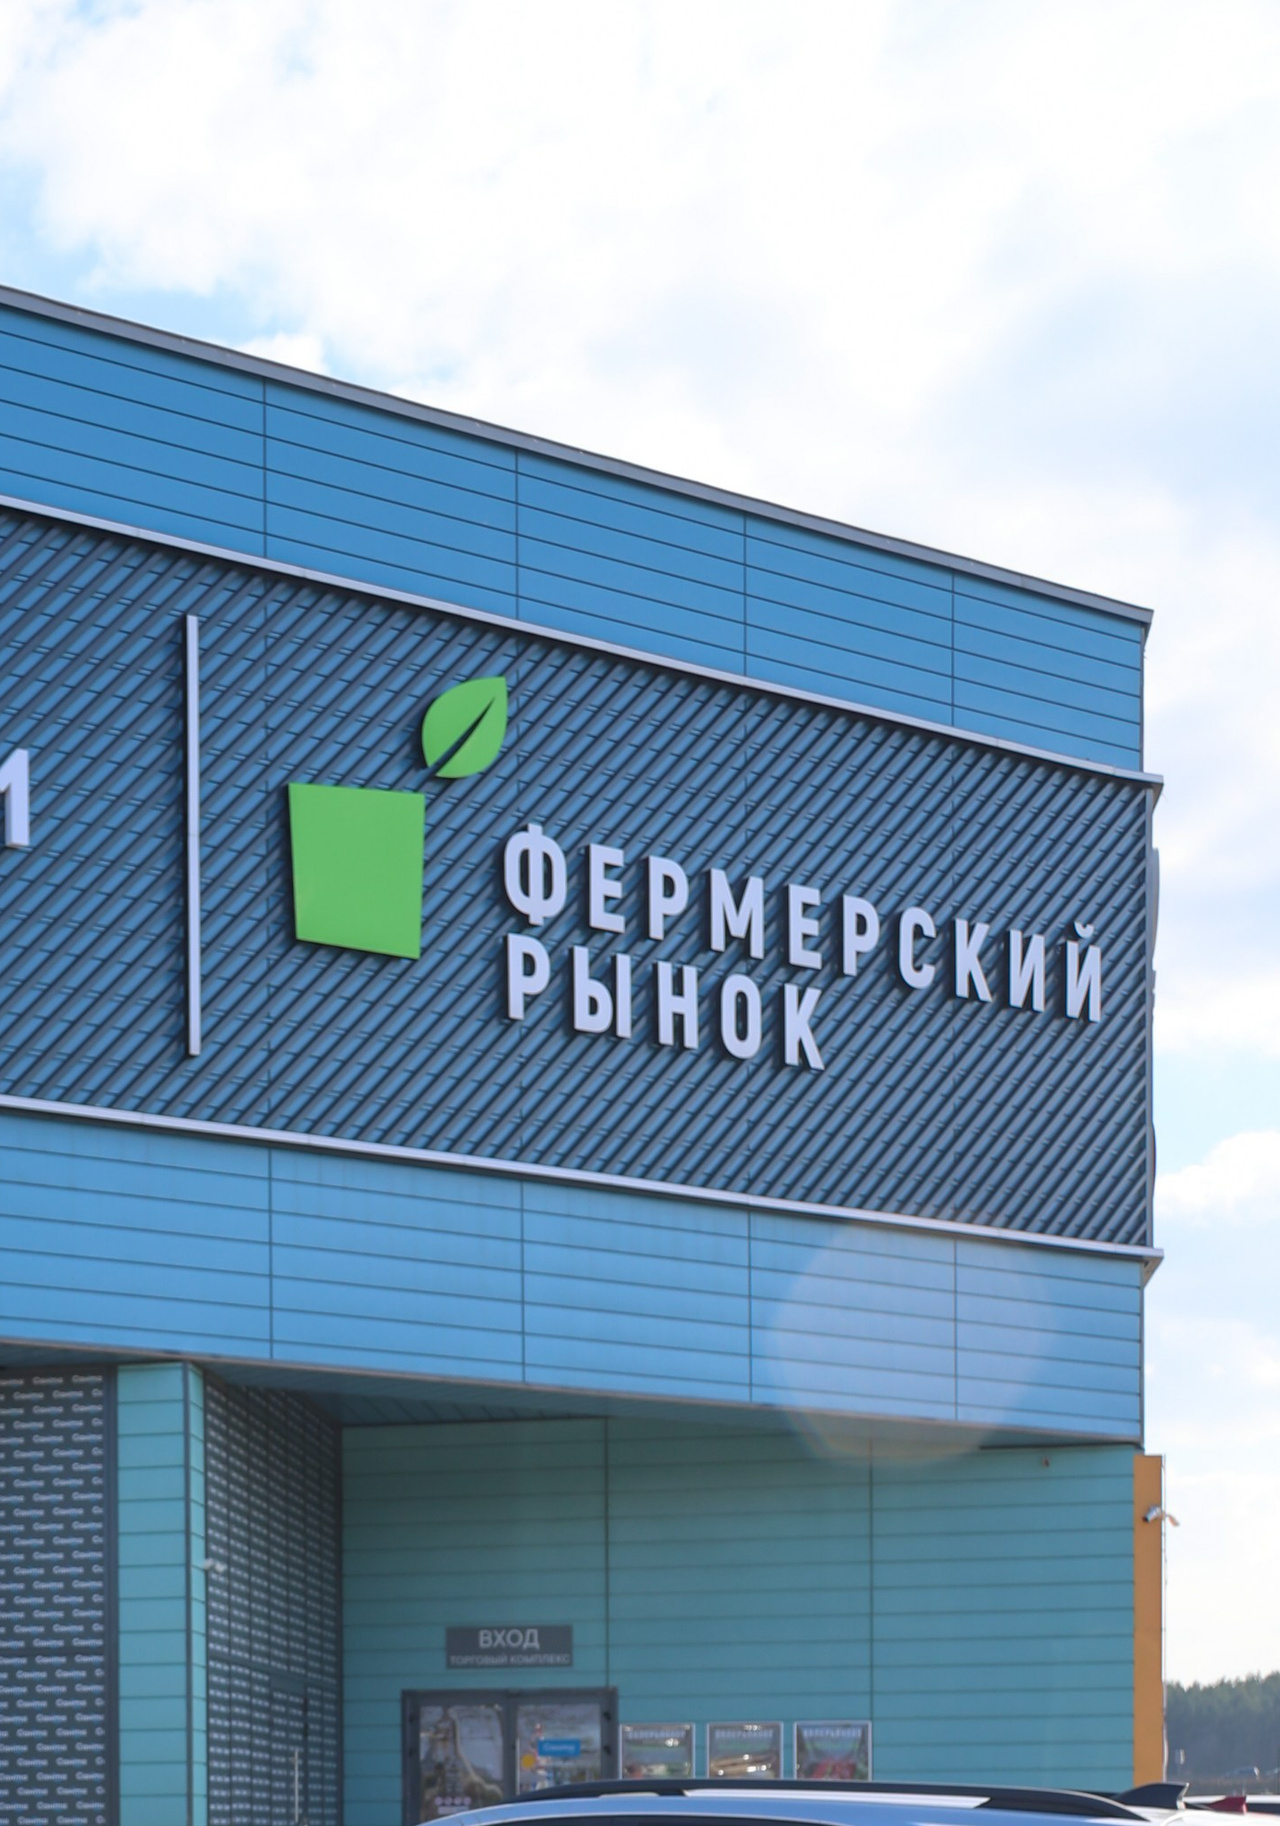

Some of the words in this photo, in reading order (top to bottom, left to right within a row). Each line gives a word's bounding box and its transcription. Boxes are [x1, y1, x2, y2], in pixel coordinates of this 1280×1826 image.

[502, 822, 1105, 1023] ФЕРМЕРСКИЙ
[505, 932, 826, 1071] РЫНОК
[449, 1654, 507, 1666] ТОРГОВЫЙ
[510, 1653, 570, 1665] КОМПЛЕКС
[478, 1628, 540, 1650] ВХОД
